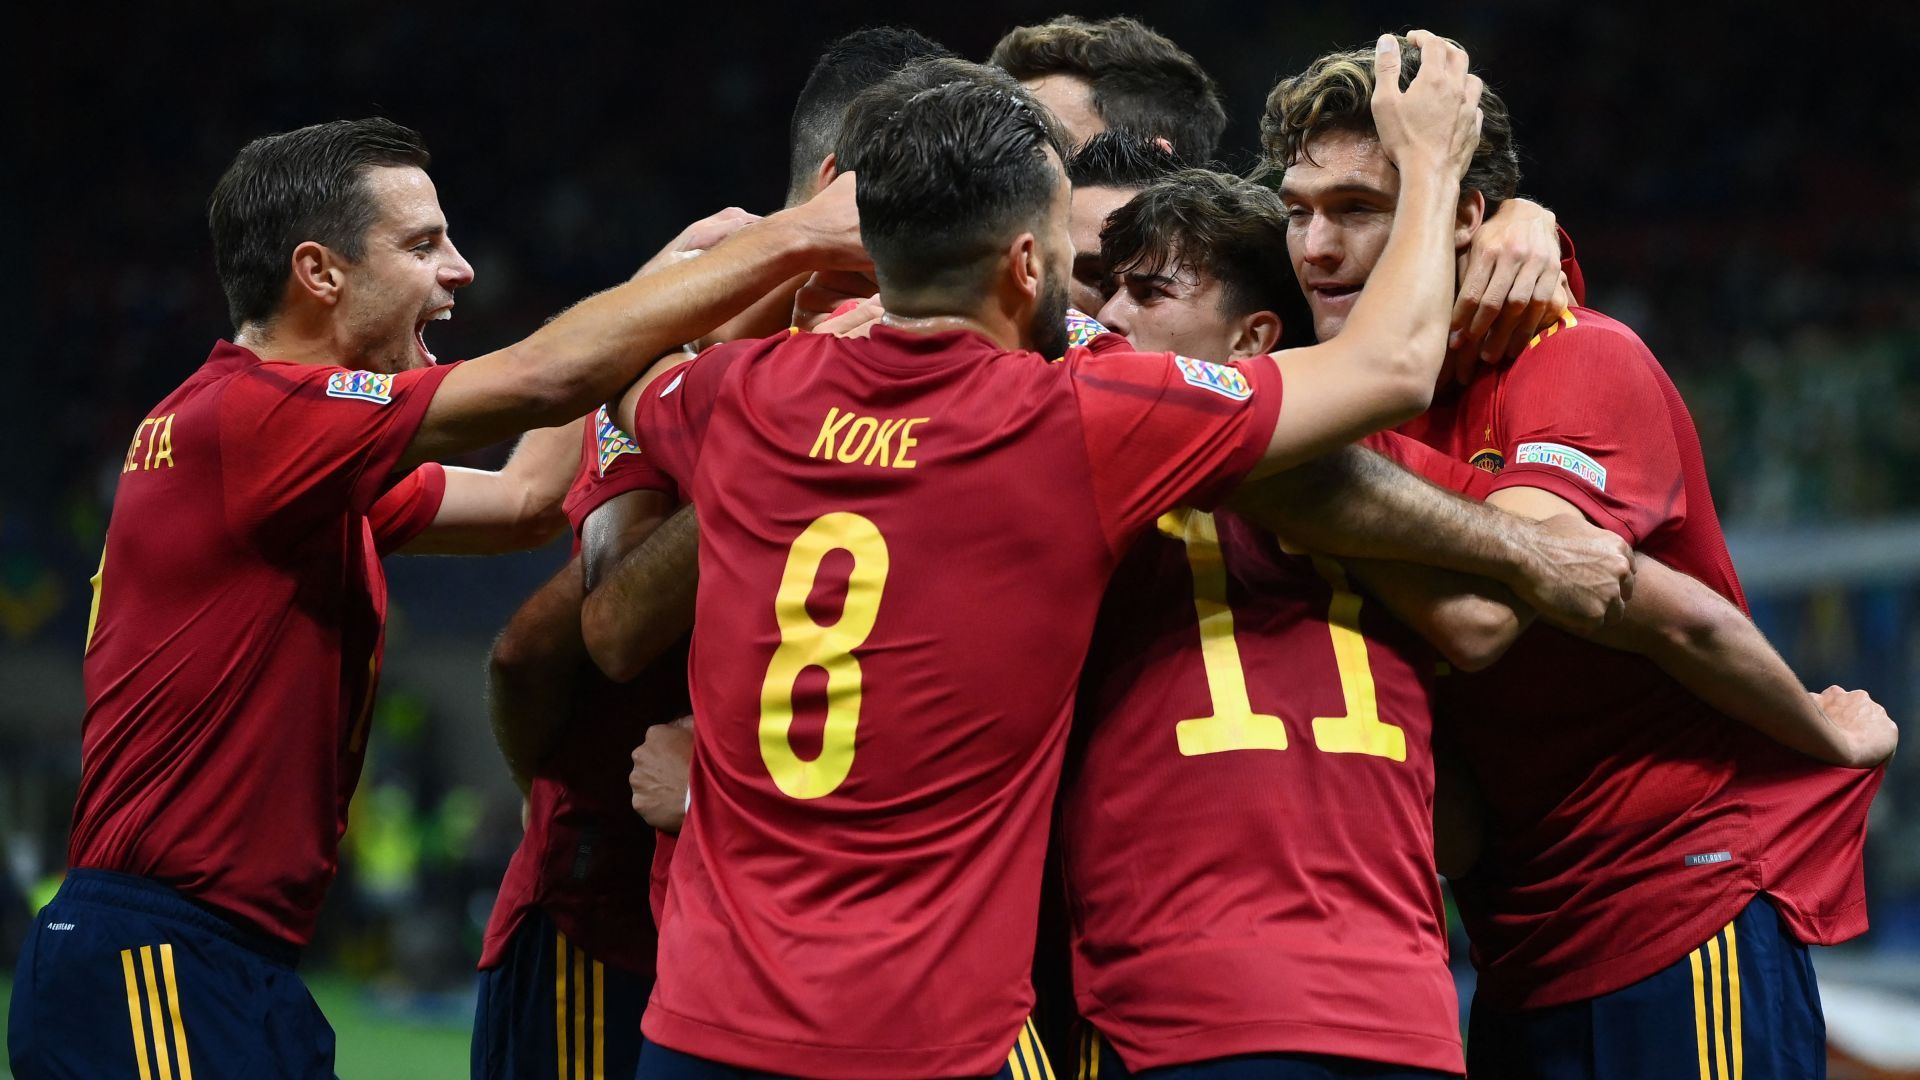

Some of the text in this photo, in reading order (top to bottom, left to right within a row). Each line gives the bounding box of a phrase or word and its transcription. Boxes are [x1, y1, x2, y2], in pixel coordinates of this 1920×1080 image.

[808, 406, 931, 469] KOKE
[1519, 444, 1543, 453] UEFA
[1519, 452, 1604, 489] FOUNDATION
[758, 511, 890, 800] 8
[1157, 508, 1407, 763] 11
